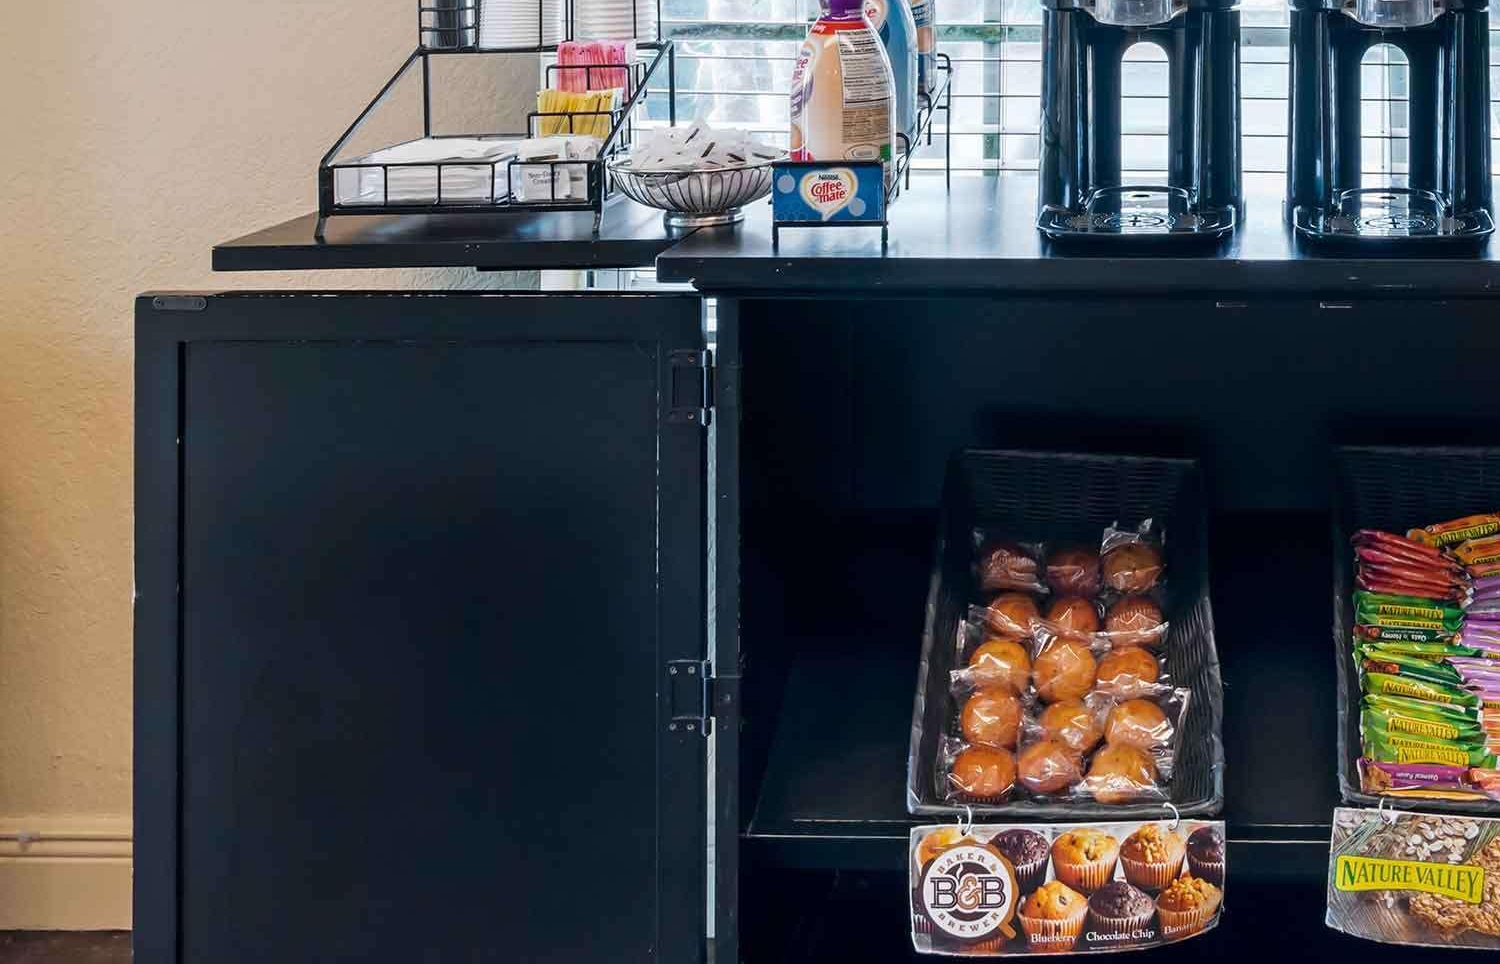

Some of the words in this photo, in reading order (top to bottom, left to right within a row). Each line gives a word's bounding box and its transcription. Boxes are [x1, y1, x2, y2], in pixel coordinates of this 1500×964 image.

[811, 180, 843, 197] Coffee
[819, 189, 846, 203] mate
[937, 853, 985, 874] BAKER
[1342, 859, 1412, 886] NATURE
[1415, 866, 1479, 899] VALLEY
[930, 875, 1006, 909] B&B
[938, 912, 999, 932] BREWER
[1031, 932, 1077, 943] Blueberry
[1086, 930, 1131, 942] Chocolate
[1131, 928, 1155, 940] Chip
